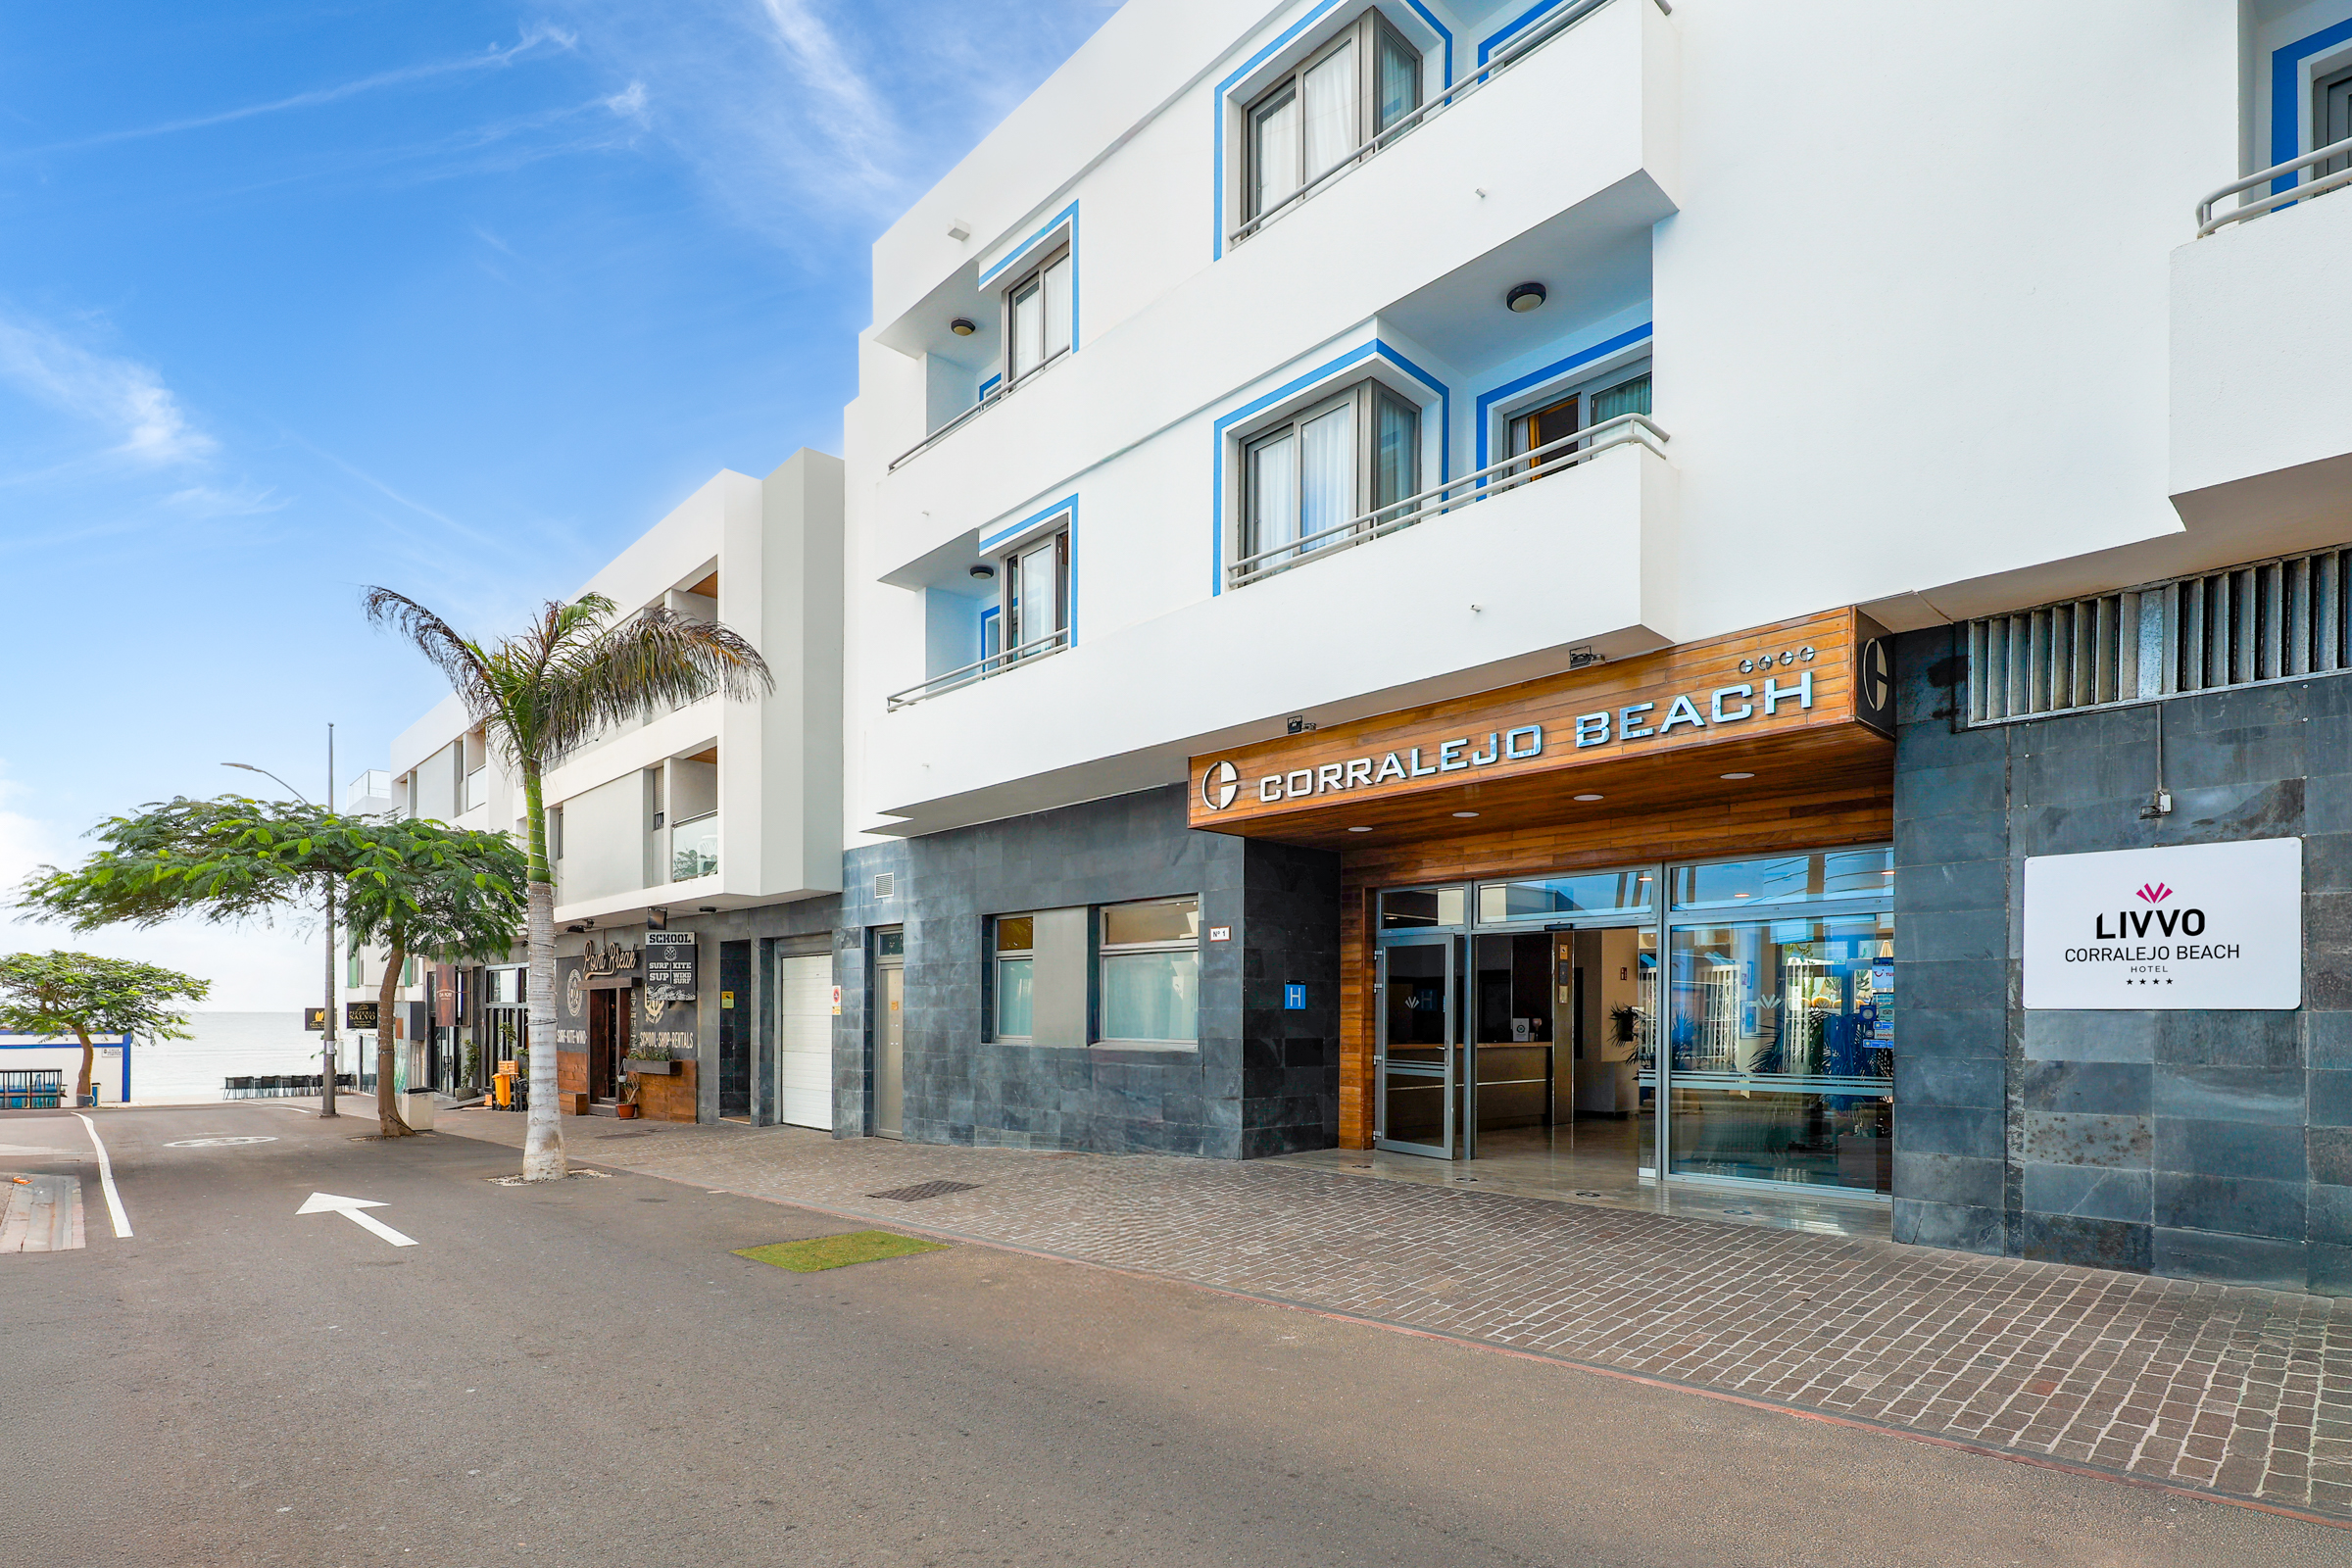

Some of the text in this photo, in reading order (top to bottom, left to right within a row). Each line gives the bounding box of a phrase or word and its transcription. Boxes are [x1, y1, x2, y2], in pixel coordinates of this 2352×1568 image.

[1259, 670, 1814, 803] CORRALEJO BEACH
[2096, 907, 2205, 939] LIVVO
[649, 933, 691, 944] SCHOOL
[583, 940, 607, 972] Point
[2065, 944, 2240, 962] CORRALEJO BEACH
[649, 972, 669, 982] SUP
[1290, 987, 1301, 1007] H
